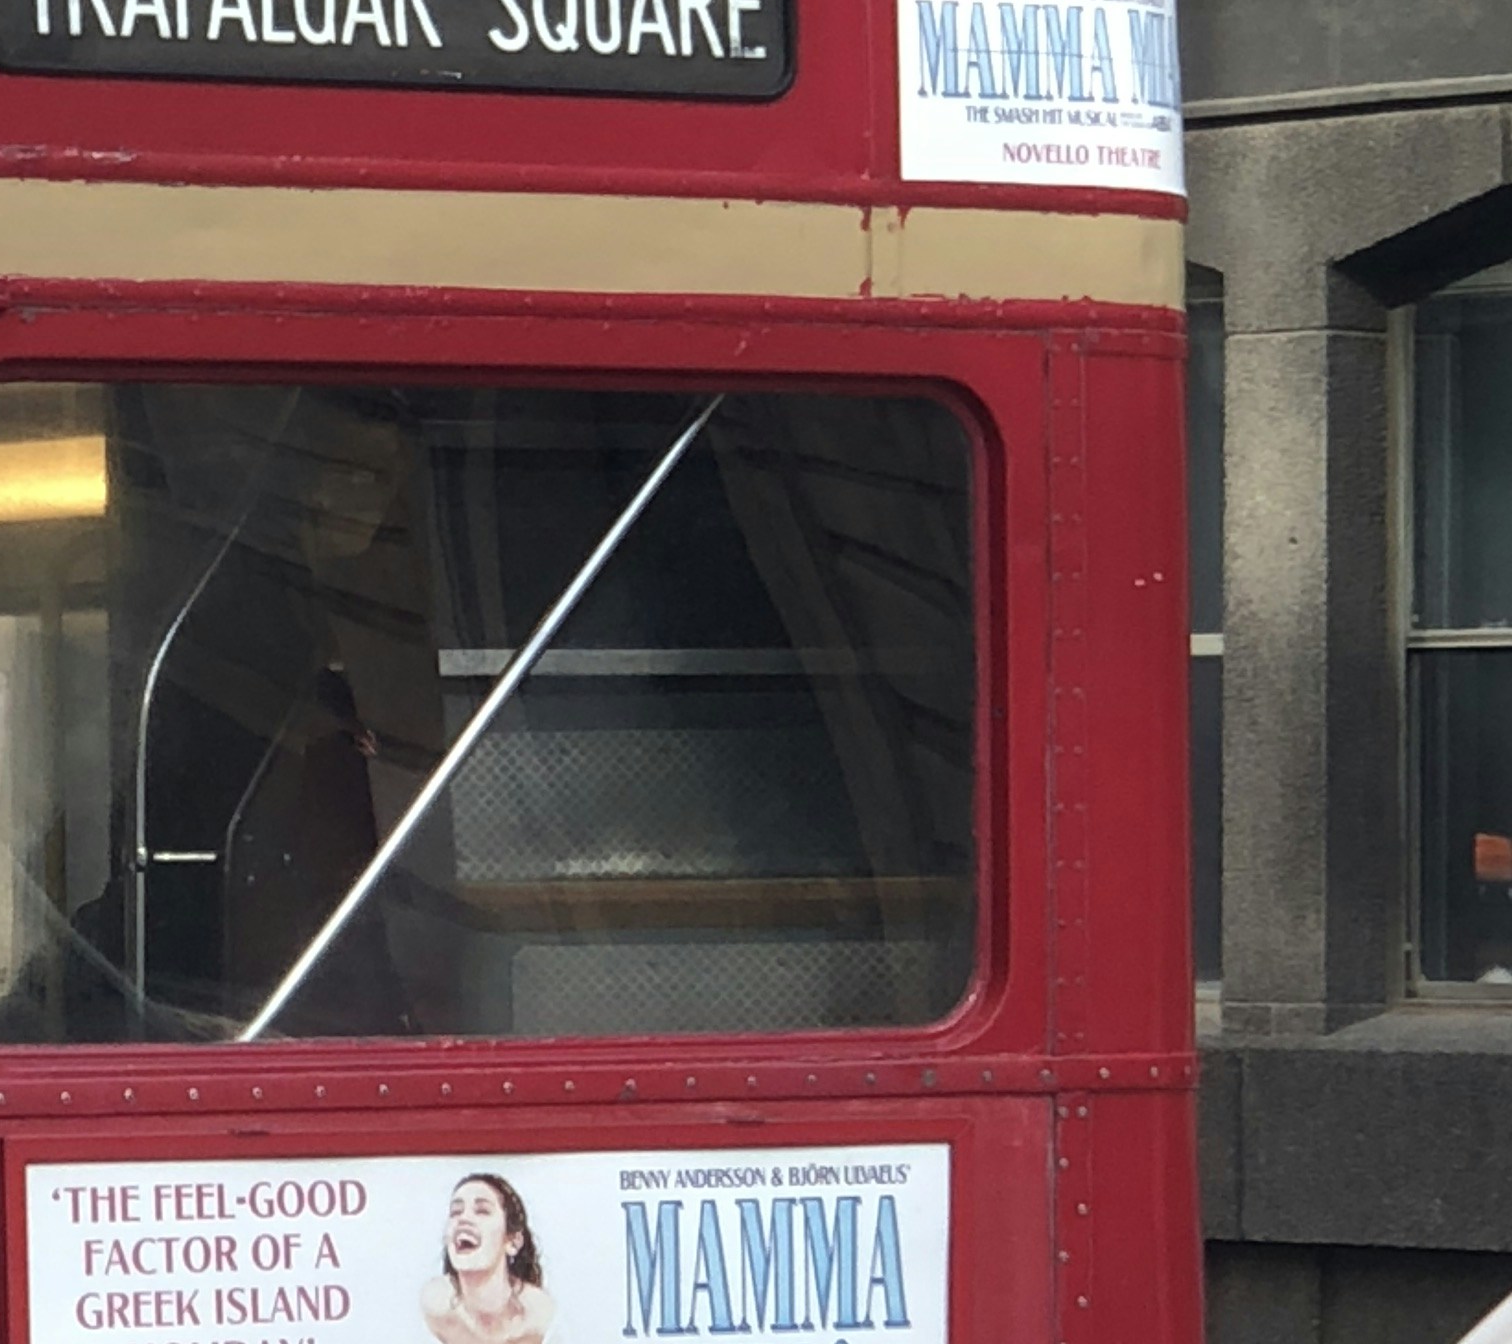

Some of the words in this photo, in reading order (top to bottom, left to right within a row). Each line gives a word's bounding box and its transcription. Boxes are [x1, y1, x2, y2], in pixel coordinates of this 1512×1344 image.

[916, 0, 1119, 103] MAMMA
[966, 106, 990, 123] THE
[995, 107, 1039, 124] SMASH
[1043, 108, 1063, 125] HIT
[1068, 110, 1118, 127] MUSICAL
[1003, 143, 1089, 165] NOVELLO
[1097, 145, 1161, 169] THEATRE
[619, 1169, 671, 1190] BENNY
[674, 1168, 766, 1189] ANDERSSON
[771, 1168, 783, 1186] &
[154, 1180, 367, 1221] FEEL-GOOD
[84, 1235, 238, 1277] FACTOR
[252, 1233, 302, 1271] OF
[315, 1233, 340, 1269] A
[621, 1195, 911, 1338] MAMMA
[75, 1289, 201, 1330] GREEK
[215, 1285, 351, 1325] ISLAND
